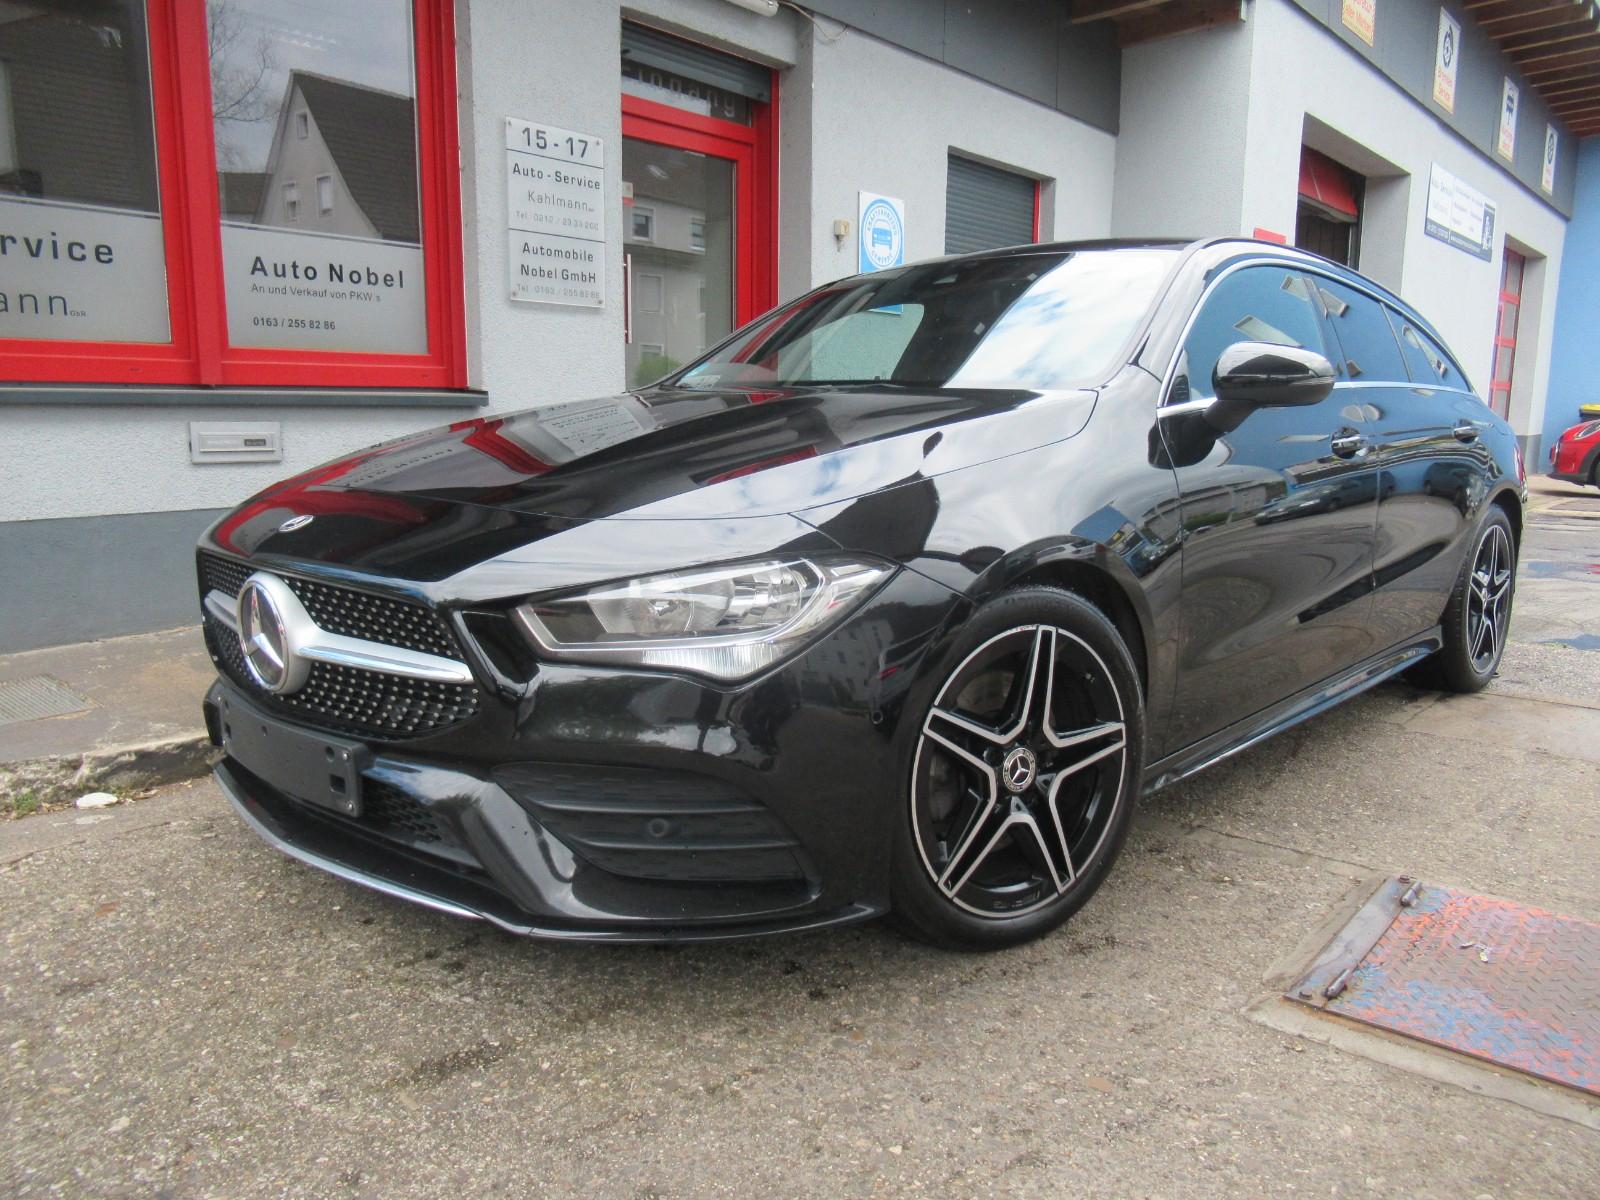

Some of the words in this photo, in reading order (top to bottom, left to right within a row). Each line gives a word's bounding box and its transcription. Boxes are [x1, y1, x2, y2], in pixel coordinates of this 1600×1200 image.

[528, 190, 588, 211] Kahlmann
[0, 231, 114, 264] rvice
[522, 242, 594, 262] Automobile
[250, 256, 317, 281] Auto
[329, 263, 404, 288] Nobel
[520, 264, 557, 279] Nobel
[561, 269, 596, 283] GmbH
[251, 283, 265, 294] An
[268, 285, 287, 295] und
[290, 286, 327, 298] Verkauf
[330, 290, 346, 299] von
[253, 316, 279, 327] 0163
[288, 318, 306, 328] 255
[309, 319, 321, 329] 82
[323, 320, 336, 330] 86
